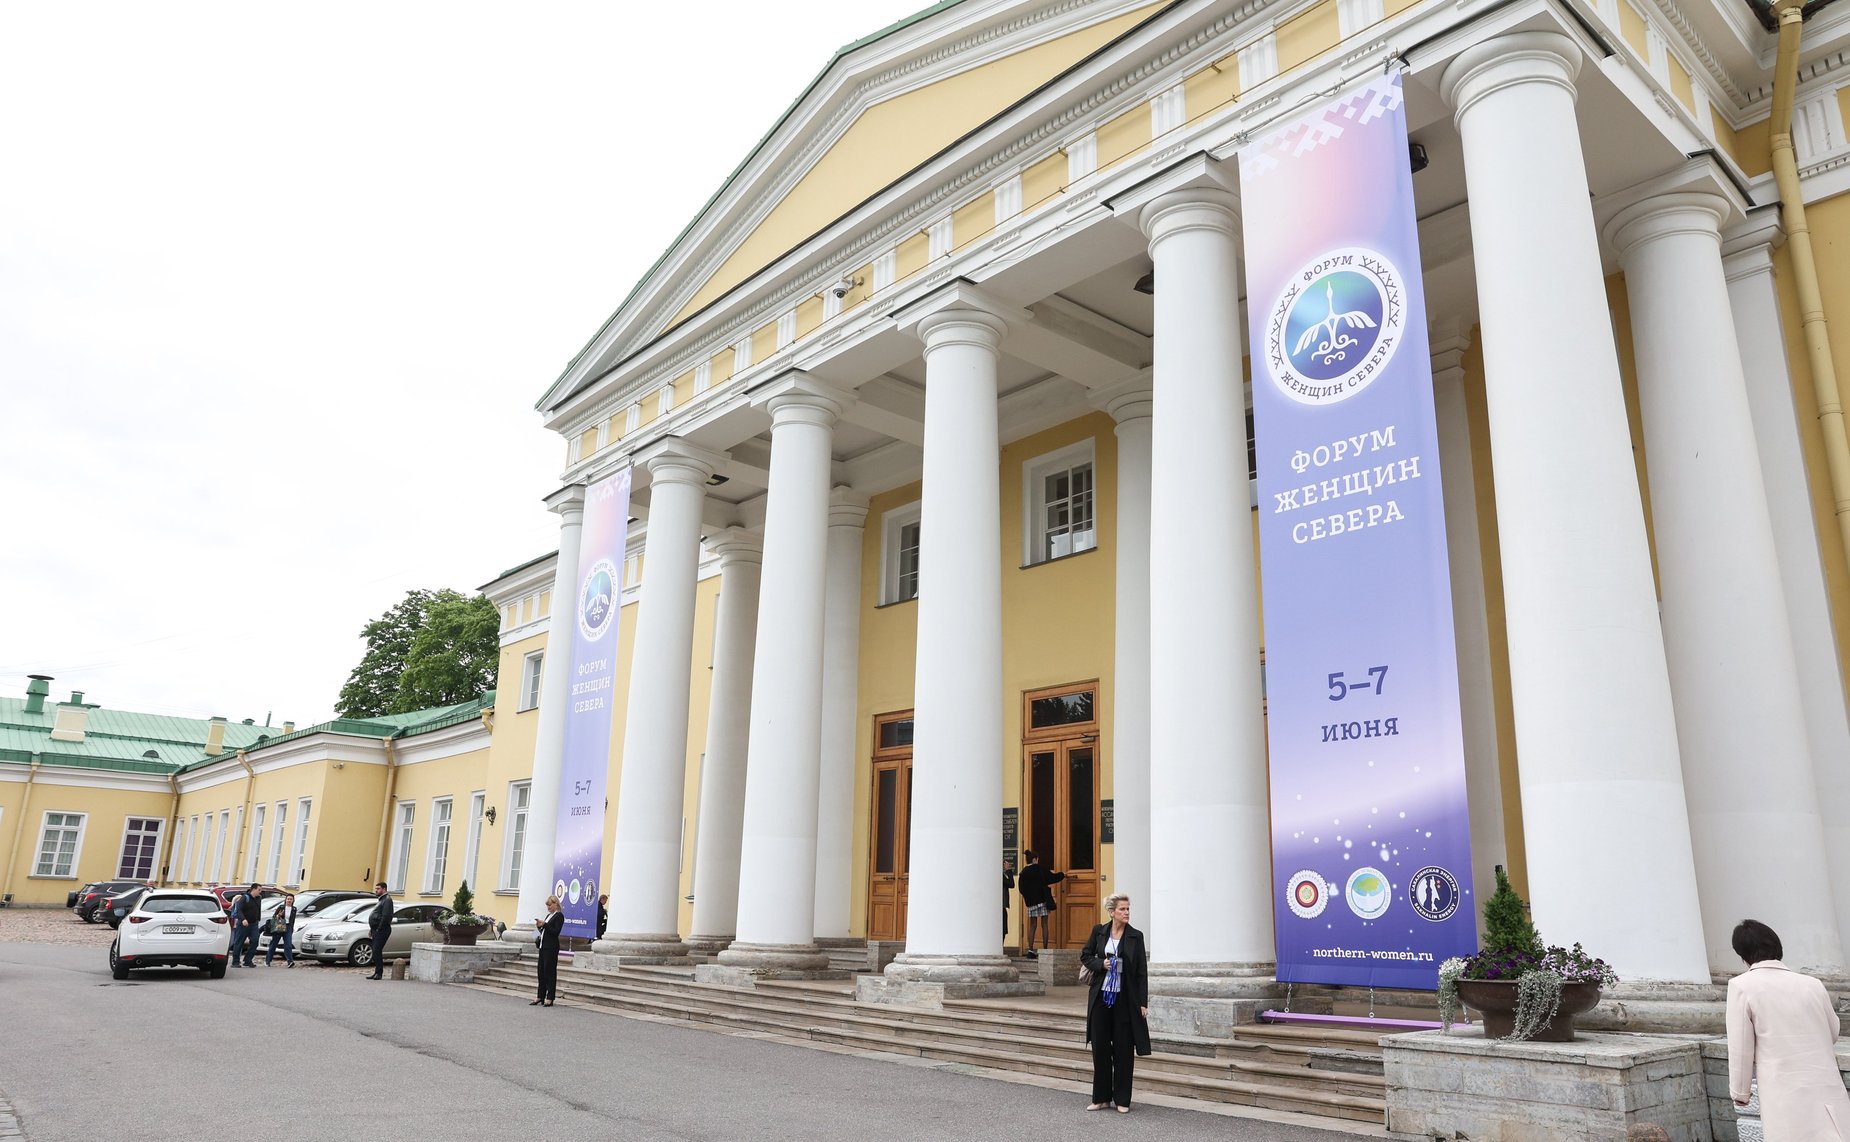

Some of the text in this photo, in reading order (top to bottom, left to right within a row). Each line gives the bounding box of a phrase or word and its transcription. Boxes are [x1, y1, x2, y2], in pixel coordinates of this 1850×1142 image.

[1303, 255, 1353, 282] ФОРУМ
[1281, 336, 1393, 399] ЖЕНЩИН СЕВЕРА
[1290, 425, 1396, 474] ФОРУМ
[1274, 456, 1421, 513] ЖЕНЩИН
[1292, 500, 1405, 544] СЕВЕРА
[578, 658, 607, 676] ФОРУМ
[571, 676, 611, 696] ЖЕНЩИН
[1328, 665, 1388, 701] 5–7
[574, 697, 604, 713] СЕВЕРА
[1414, 902, 1456, 919] SAKHALIN ENERGY
[1313, 947, 1434, 962] northern-women.ru
